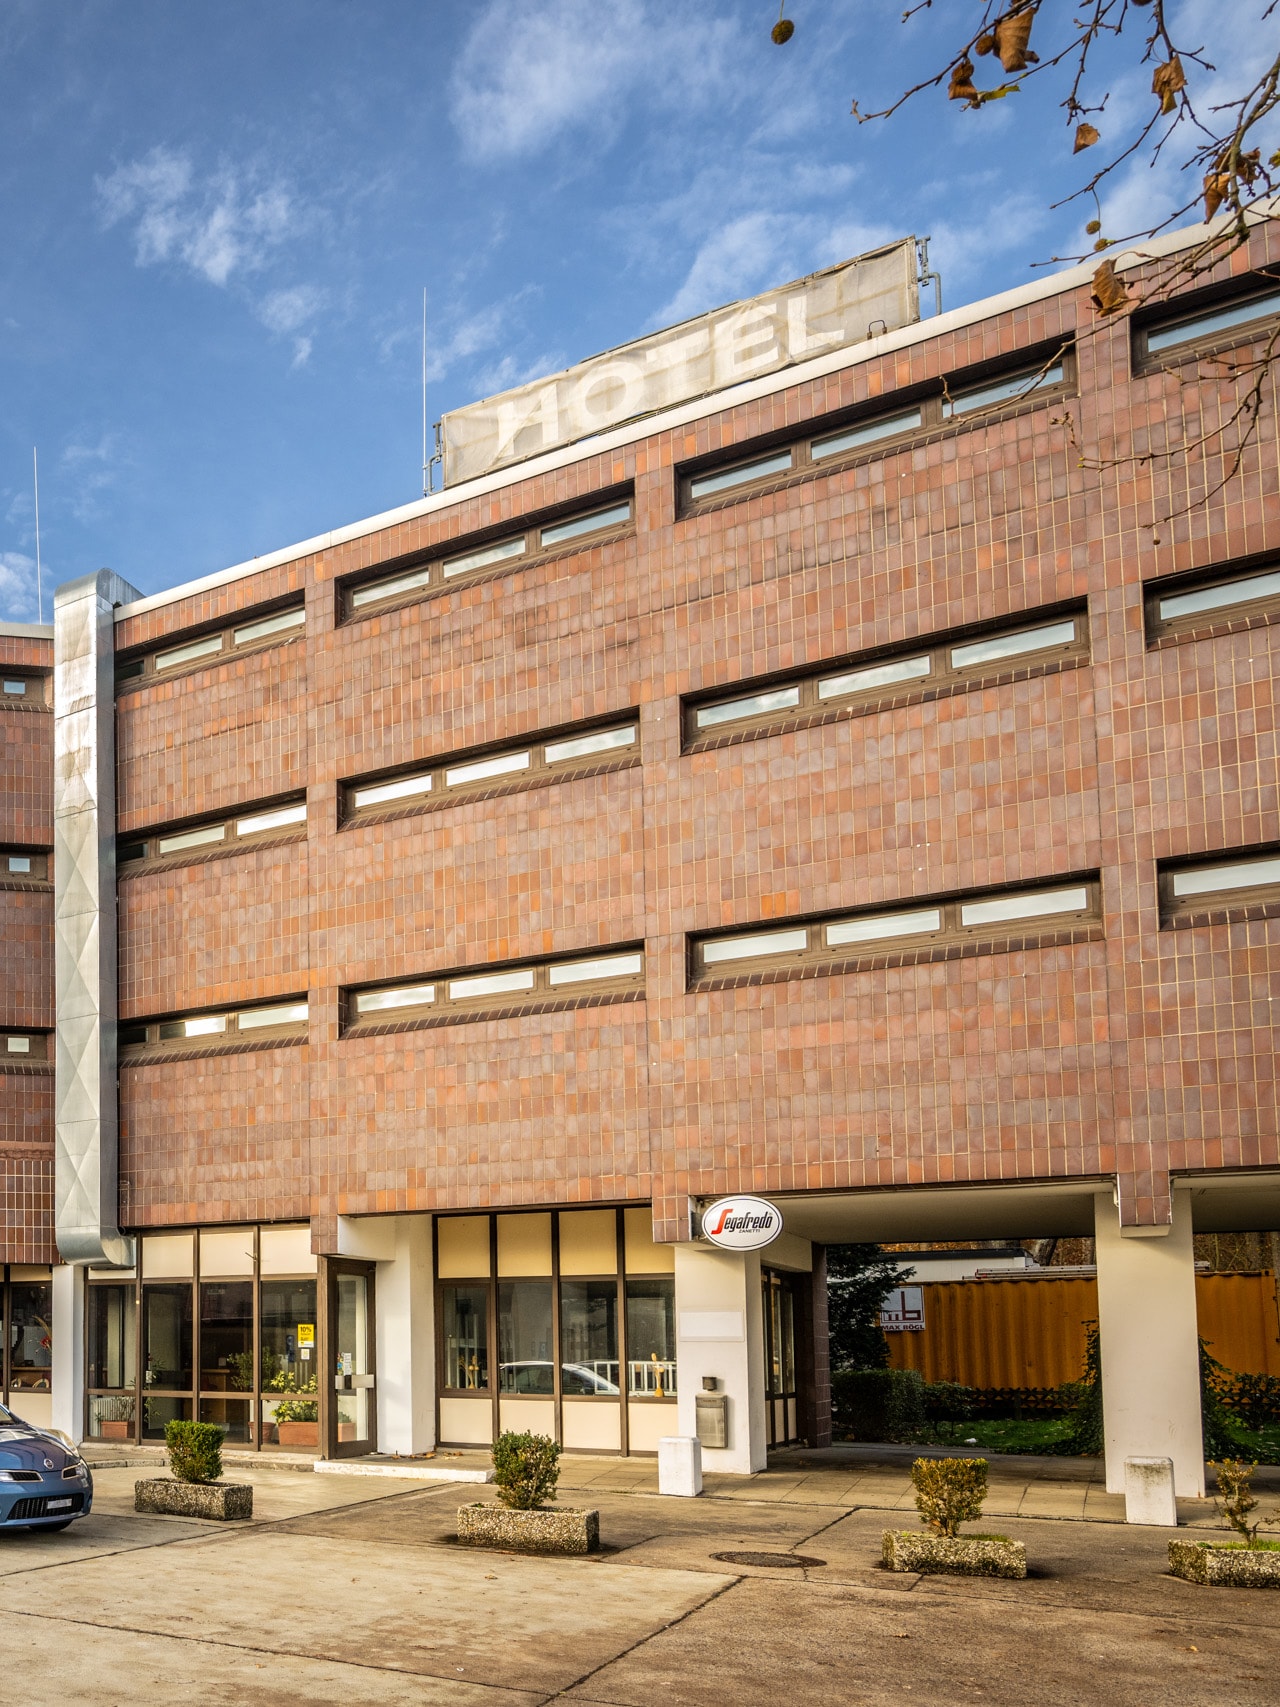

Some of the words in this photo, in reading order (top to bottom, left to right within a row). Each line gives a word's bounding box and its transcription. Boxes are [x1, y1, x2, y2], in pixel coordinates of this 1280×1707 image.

[497, 294, 845, 456] HOTEL
[710, 1208, 773, 1235] Segafredo
[300, 1325, 312, 1333] 10%
